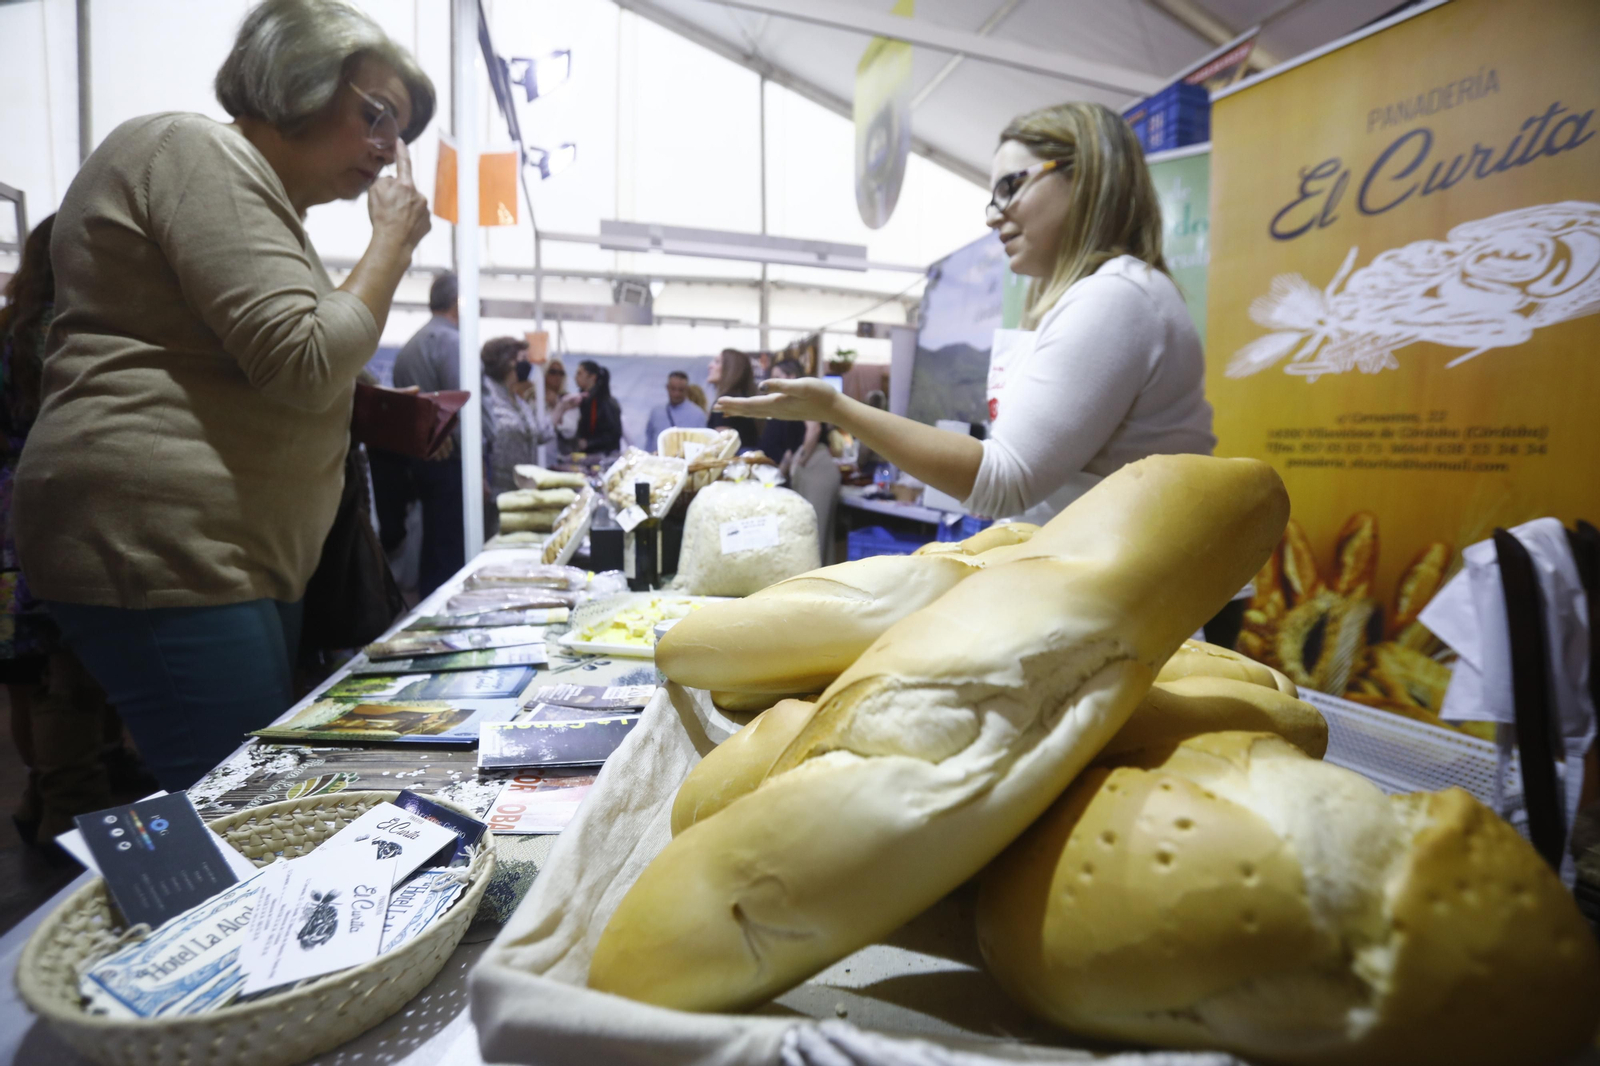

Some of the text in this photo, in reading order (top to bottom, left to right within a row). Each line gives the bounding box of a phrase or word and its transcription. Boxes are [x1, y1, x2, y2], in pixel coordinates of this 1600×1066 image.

[1366, 65, 1501, 134] PANADERÍA
[1269, 100, 1599, 241] El Curita
[348, 884, 377, 934] El Curita
[150, 944, 201, 981] Hotel
[190, 933, 222, 951] La
